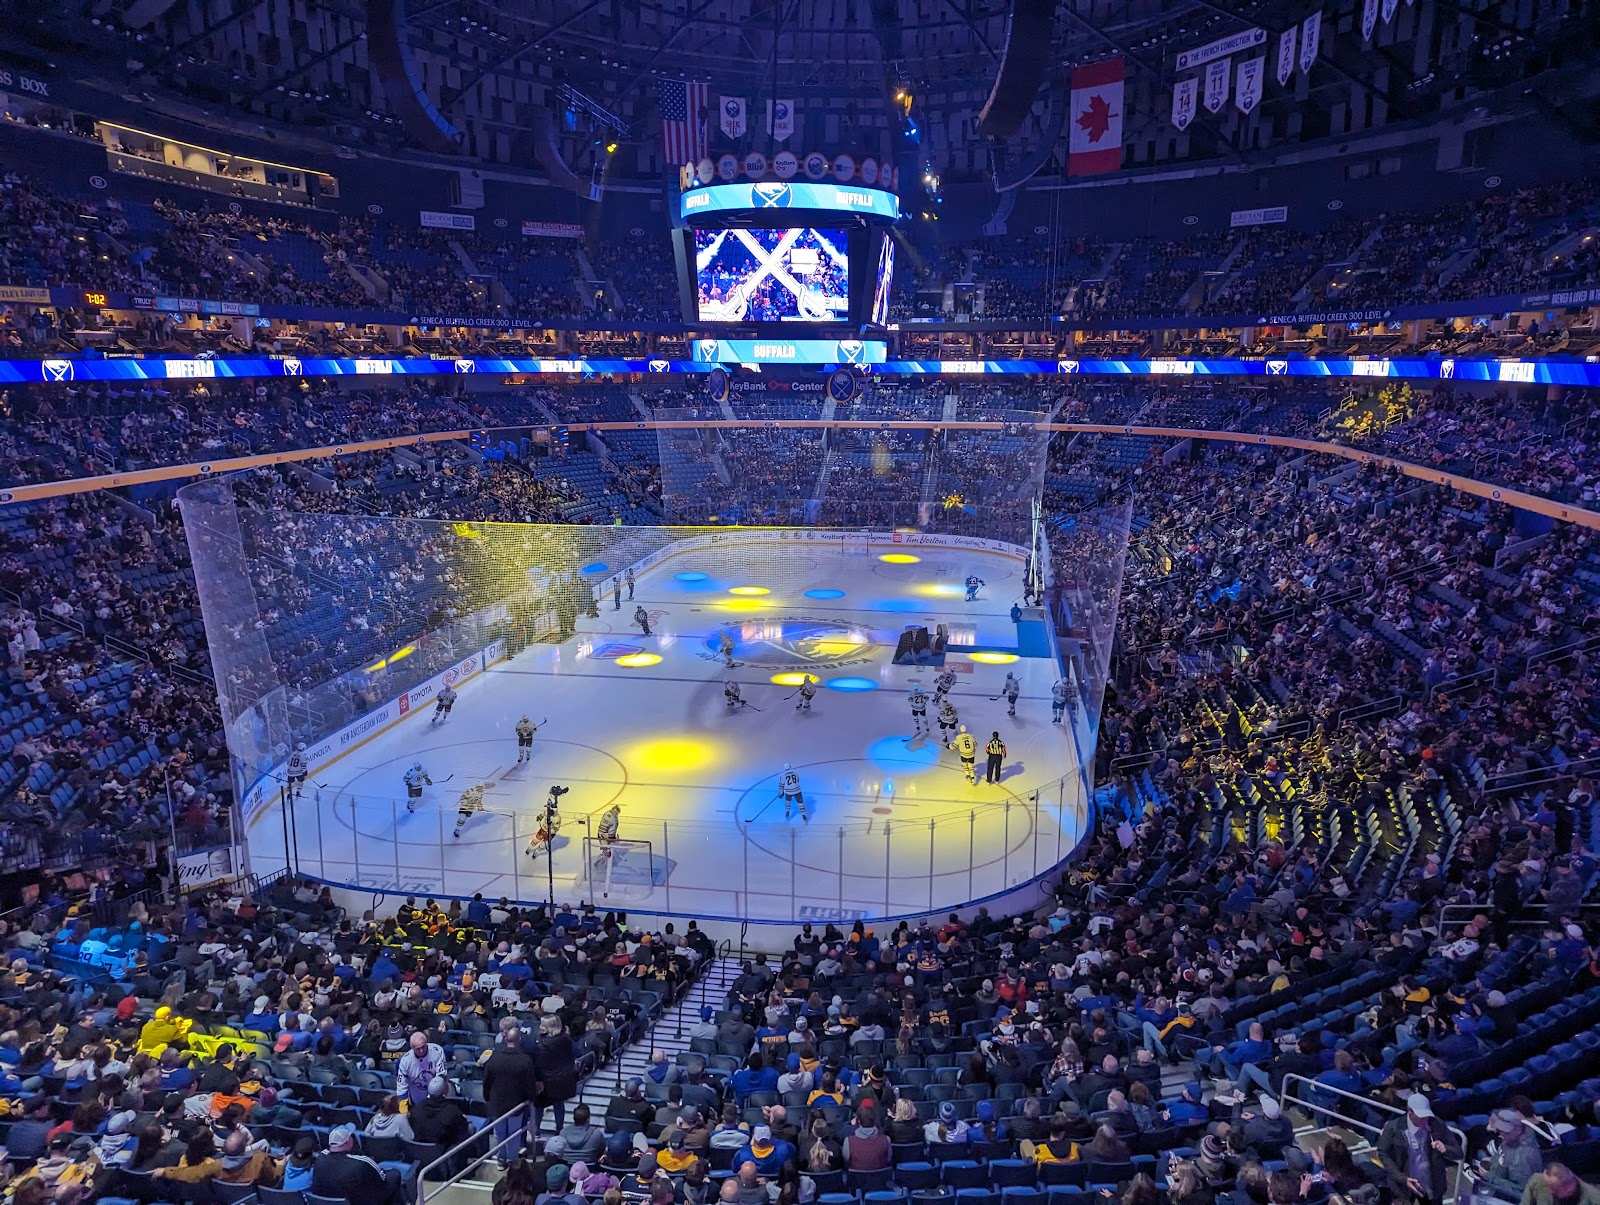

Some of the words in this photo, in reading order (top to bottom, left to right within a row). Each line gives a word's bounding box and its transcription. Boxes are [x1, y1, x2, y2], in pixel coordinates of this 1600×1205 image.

[1191, 51, 1200, 61] THE
[1201, 44, 1219, 58] FRENCH
[1221, 34, 1250, 52] CONNECTION
[20, 76, 49, 96] BOX
[1212, 75, 1223, 92] 11
[1246, 74, 1255, 90] 7
[1179, 94, 1191, 110] 14
[747, 161, 764, 171] Blue
[836, 191, 873, 207] BUFFALO
[86, 293, 105, 305] 7:02
[134, 297, 152, 305] TRULY
[420, 316, 444, 325] SENECA
[445, 317, 474, 326] BUFFALO
[476, 318, 495, 326] CREEK
[496, 318, 509, 327] 300
[511, 319, 531, 327] LEVEL
[1270, 315, 1297, 324] SENECA
[1298, 313, 1326, 323] BUFFALO
[1327, 312, 1348, 321] CREEK
[1349, 311, 1363, 320] 300
[1365, 310, 1382, 320] LEVEL
[753, 345, 796, 358] BUFFALO
[165, 360, 215, 377] BUFFALO
[355, 360, 392, 374] BUFFALO
[540, 360, 582, 372] BUFFALO
[941, 360, 985, 373] BUFFALO
[1150, 361, 1194, 374] BUFFALO
[1352, 361, 1390, 376] BUFFALO
[1499, 362, 1535, 382] BUFFALO
[729, 381, 767, 391] KeyBank
[791, 382, 824, 391] Center
[906, 534, 919, 543] Tim
[920, 535, 947, 545] Hortons
[410, 686, 433, 703] TOYOTA
[914, 694, 924, 704] 27
[340, 732, 350, 746] NEW
[350, 716, 376, 739] AMSTERDAM
[376, 709, 389, 726] VODKA
[964, 740, 971, 749] 6
[290, 757, 300, 768] 18
[785, 773, 798, 785] 28
[253, 786, 263, 801] air
